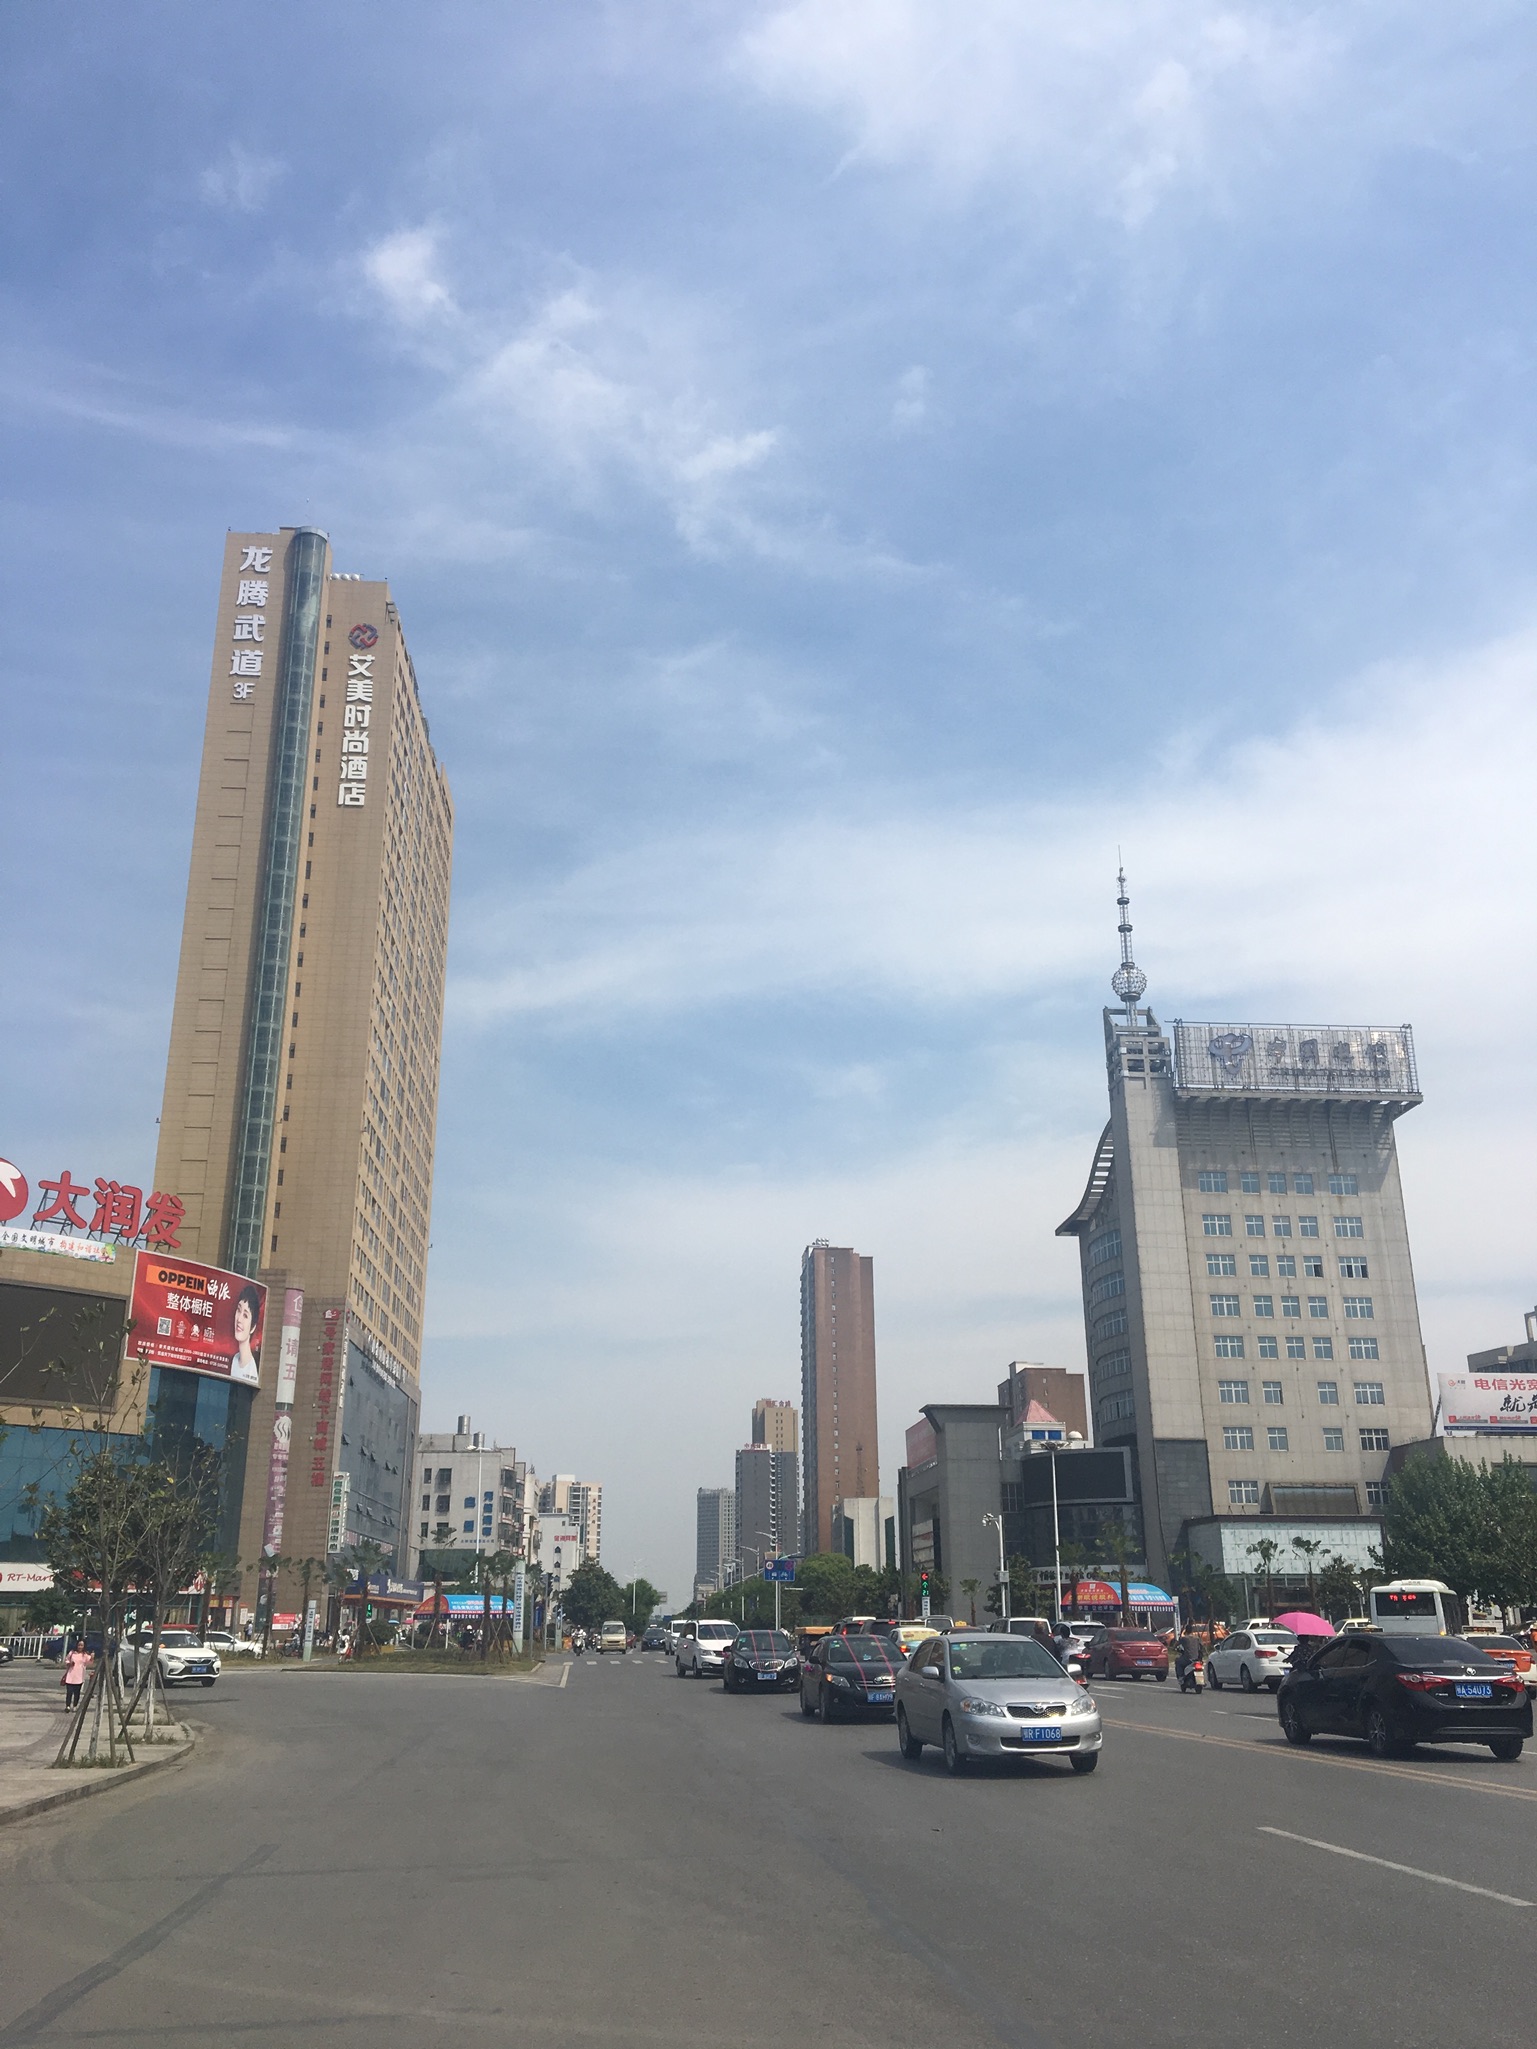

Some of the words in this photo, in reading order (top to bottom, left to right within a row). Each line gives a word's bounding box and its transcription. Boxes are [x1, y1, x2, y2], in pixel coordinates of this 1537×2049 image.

[229, 546, 273, 677] 龙腾武道
[233, 682, 255, 699] 3F
[338, 654, 374, 807] 艾美时尚酒店
[32, 1170, 187, 1250] 大润发
[158, 1270, 205, 1291] OPPEIN
[207, 1279, 231, 1301] 欧派
[166, 1292, 214, 1318] 整体橱柜
